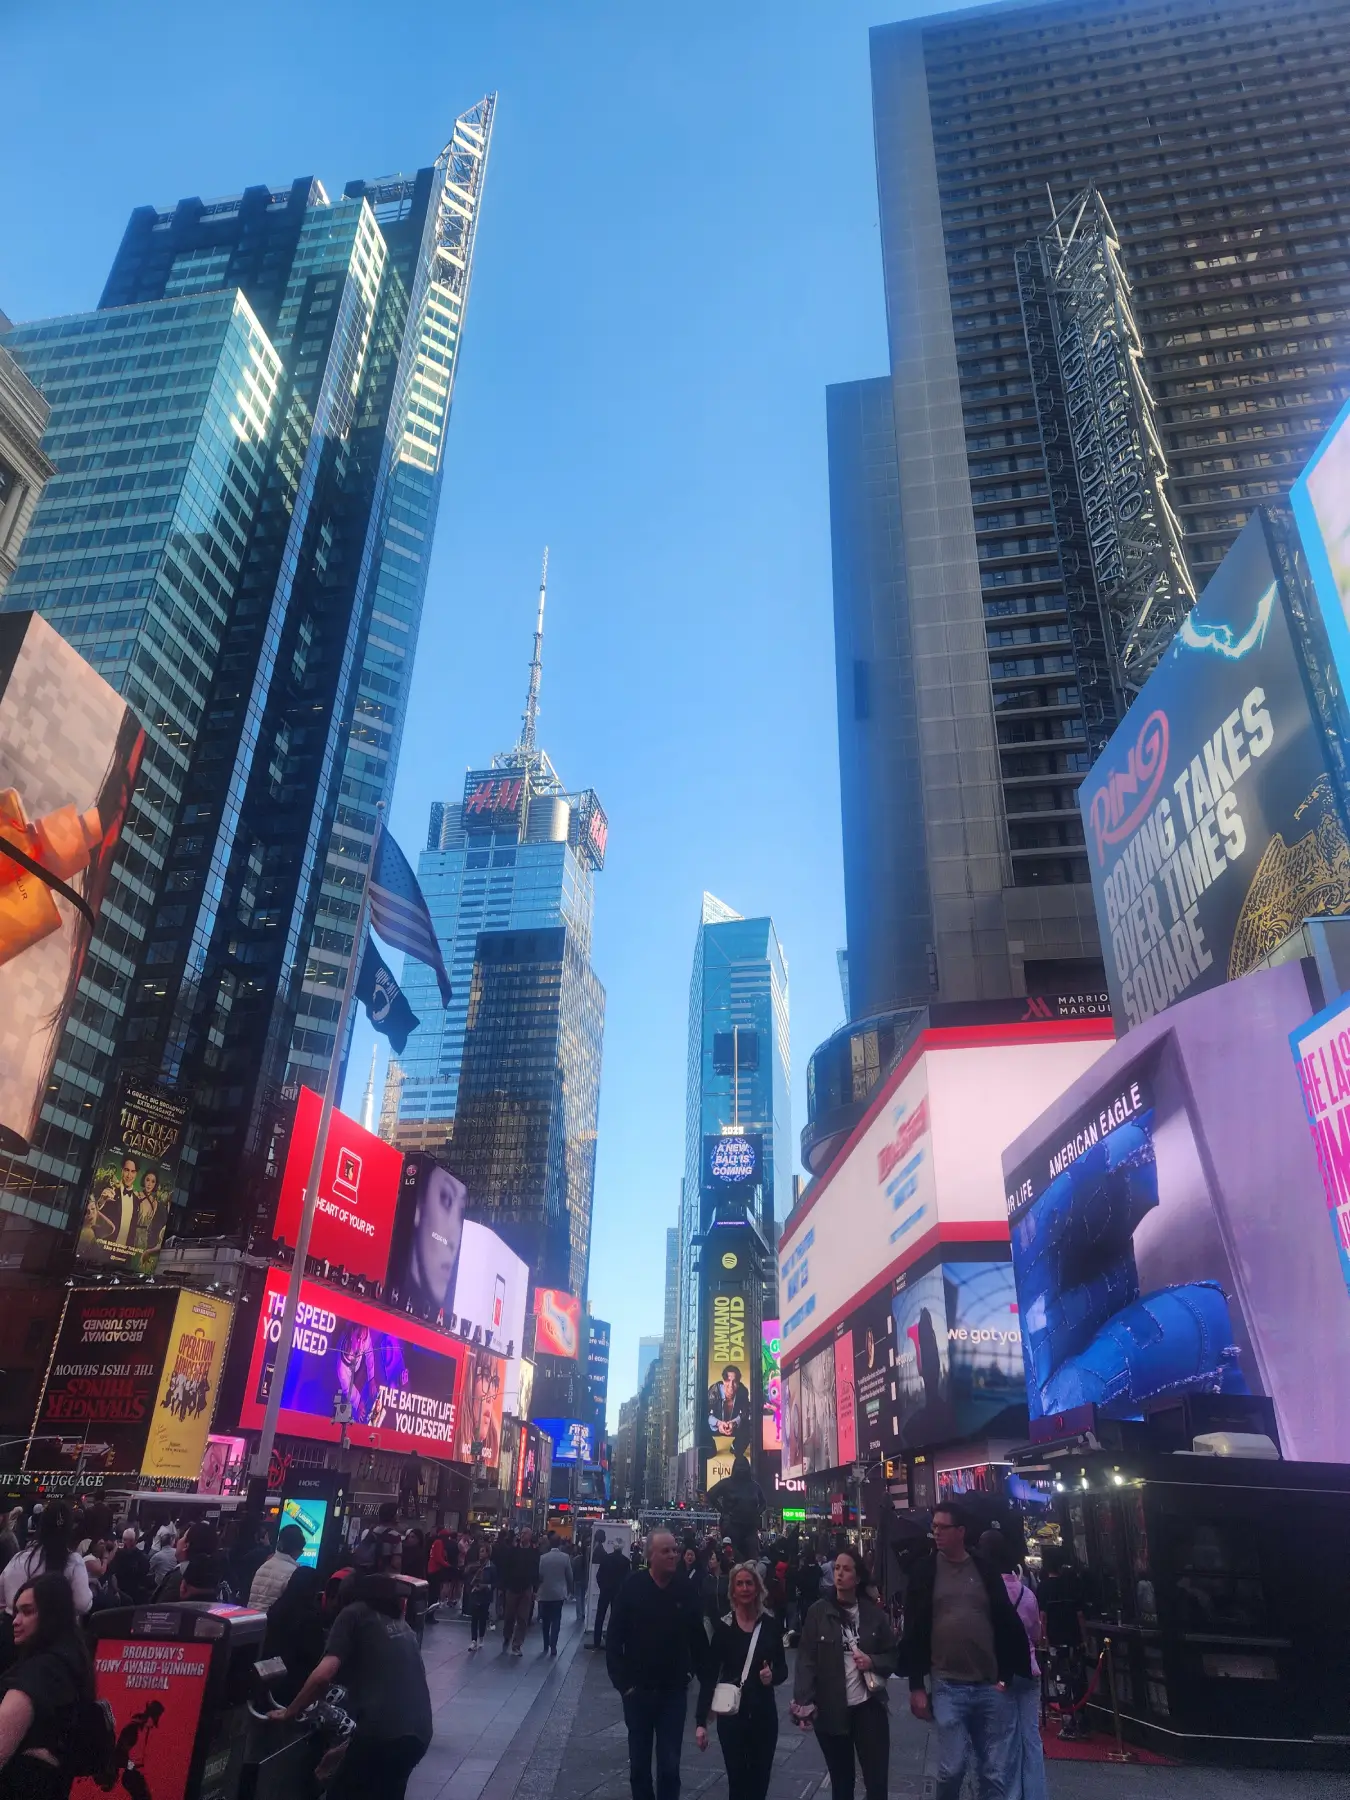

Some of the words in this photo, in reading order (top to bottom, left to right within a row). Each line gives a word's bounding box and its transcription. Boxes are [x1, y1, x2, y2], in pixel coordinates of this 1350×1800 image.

[1103, 797, 1171, 933] BOXING
[1173, 686, 1275, 827] TAKES
[1112, 882, 1165, 985] OVER
[1158, 790, 1247, 922] TIMES
[1121, 901, 1214, 1032] SQUARE
[1058, 993, 1108, 1005] MARRIO
[1059, 1005, 1112, 1015] MARQUI
[137, 1098, 175, 1118] EXTRAVAGANZA
[159, 1101, 186, 1115] BROADWAY
[120, 1107, 142, 1131] THE
[142, 1119, 178, 1144] GREAT
[1049, 1118, 1098, 1179] AMERICAN
[1100, 1082, 1142, 1136] EAGLE
[122, 1130, 172, 1158] GATSBY
[725, 1143, 749, 1152] NEW
[716, 1155, 740, 1164] BALL
[740, 1155, 750, 1163] IS
[713, 1166, 752, 1176] COMING
[1016, 1179, 1033, 1207] LIFE
[315, 1197, 339, 1217] HEART
[339, 1209, 349, 1222] OF
[349, 1213, 366, 1233] YOUR
[365, 1222, 375, 1237] PC
[268, 1290, 287, 1318] TH
[295, 1302, 337, 1333] SPEED
[83, 1319, 123, 1330] TURNED
[125, 1319, 148, 1330] HAS
[714, 1296, 730, 1362] DAMIANO
[730, 1296, 745, 1362] DAVID
[81, 1331, 144, 1342] BROADWAY
[263, 1316, 282, 1343] YO
[292, 1326, 328, 1356] NEED
[948, 1328, 967, 1340] we
[971, 1327, 998, 1344] got
[179, 1333, 216, 1362] OPERATION
[54, 1364, 99, 1375] SHADOW
[100, 1364, 131, 1375] FIRST
[133, 1364, 154, 1375] THE
[67, 1379, 135, 1398] THINGS
[45, 1395, 146, 1419] STRANGER
[379, 1385, 399, 1409] THE
[399, 1391, 439, 1418] BATTERY
[438, 1401, 456, 1423] LIFE
[395, 1412, 415, 1435] YOU
[414, 1417, 454, 1442] DESERVE
[41, 1474, 104, 1486] LUGGAGE
[712, 1467, 731, 1475] FUN
[160, 1475, 192, 1489] LUGGAGE
[122, 1645, 185, 1661] BROADWAY'S
[95, 1658, 122, 1674] TONY
[121, 1659, 205, 1676] AWARD-WINNING
[125, 1675, 169, 1690] MUSICAL
